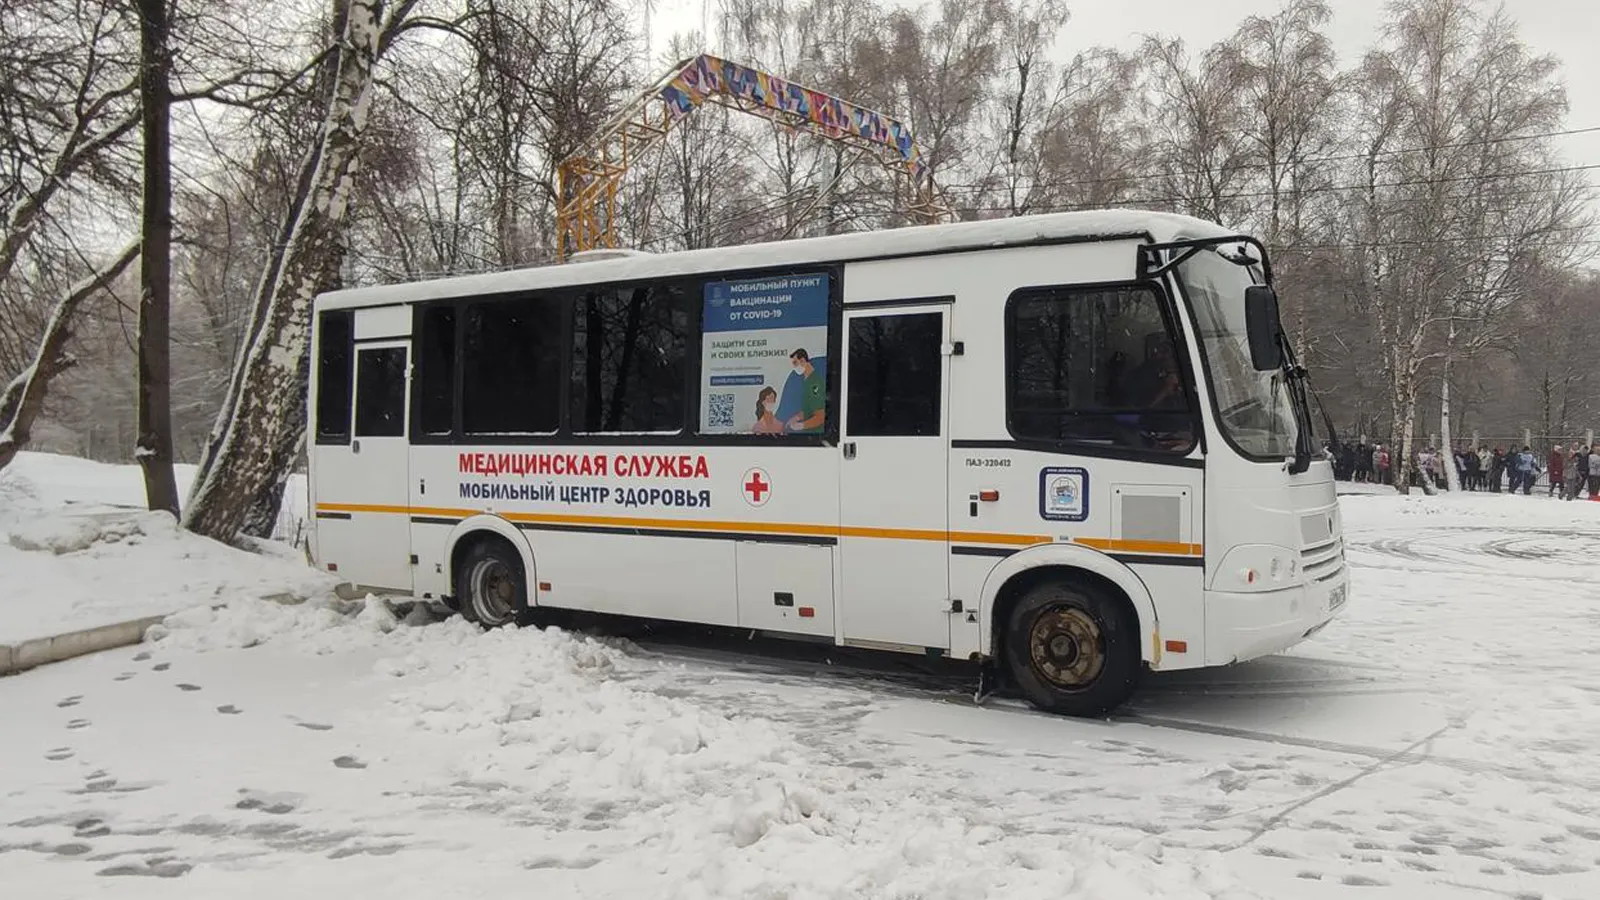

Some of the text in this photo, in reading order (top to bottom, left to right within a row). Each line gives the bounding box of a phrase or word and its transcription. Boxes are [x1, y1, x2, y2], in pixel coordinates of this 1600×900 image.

[730, 278, 820, 293] МОБИЛЬНЫЙ ПУНКТ
[730, 294, 792, 307] ВАКЦИНАЦИИ
[730, 309, 782, 320] ОТ COVID-19
[711, 339, 767, 349] ЗАЩИТИ СЕБЯ
[711, 349, 788, 359] И СВОИХ БЛИЗКИХ!
[459, 453, 709, 478] МЕДИЦИНСКАЯ СЛУЖБА
[459, 481, 711, 508] МОБИЛЬНЫЙ ЦЕНТР ЗДОРОВЬЯ
